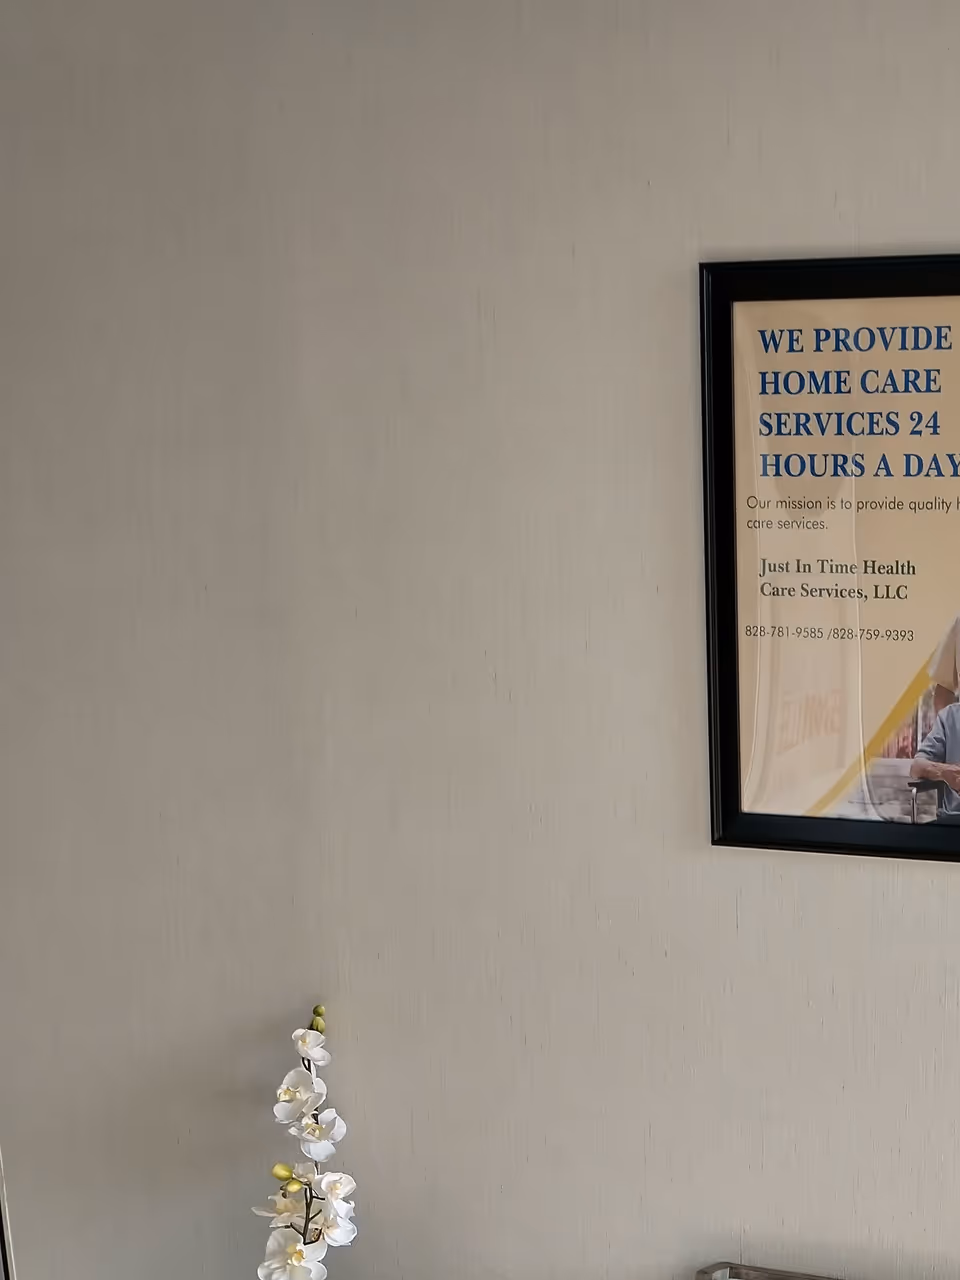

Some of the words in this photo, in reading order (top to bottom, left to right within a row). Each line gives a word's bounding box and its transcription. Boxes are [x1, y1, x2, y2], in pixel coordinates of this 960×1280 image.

[758, 328, 804, 353] WE
[812, 325, 953, 352] PROVIDE
[758, 369, 852, 396] HOME
[860, 368, 942, 394] CARE
[758, 411, 900, 437] SERVICES
[909, 410, 941, 436] 24
[760, 452, 866, 478] HOURS
[873, 454, 896, 477] A
[746, 496, 772, 511] Our
[775, 496, 822, 511] mission
[826, 497, 837, 511] is
[840, 498, 853, 512] to
[856, 496, 905, 515] provide
[908, 496, 952, 515] quality
[746, 518, 774, 530] care
[776, 516, 828, 531] services.
[759, 558, 791, 578] Just
[795, 559, 814, 576] In
[818, 559, 858, 576] Time
[862, 559, 917, 576] Health
[760, 582, 796, 599] Care
[800, 583, 868, 602] Services,
[873, 584, 908, 600] LLC
[745, 625, 824, 639] 828-781-9585
[827, 628, 915, 642] /828-759-9393
